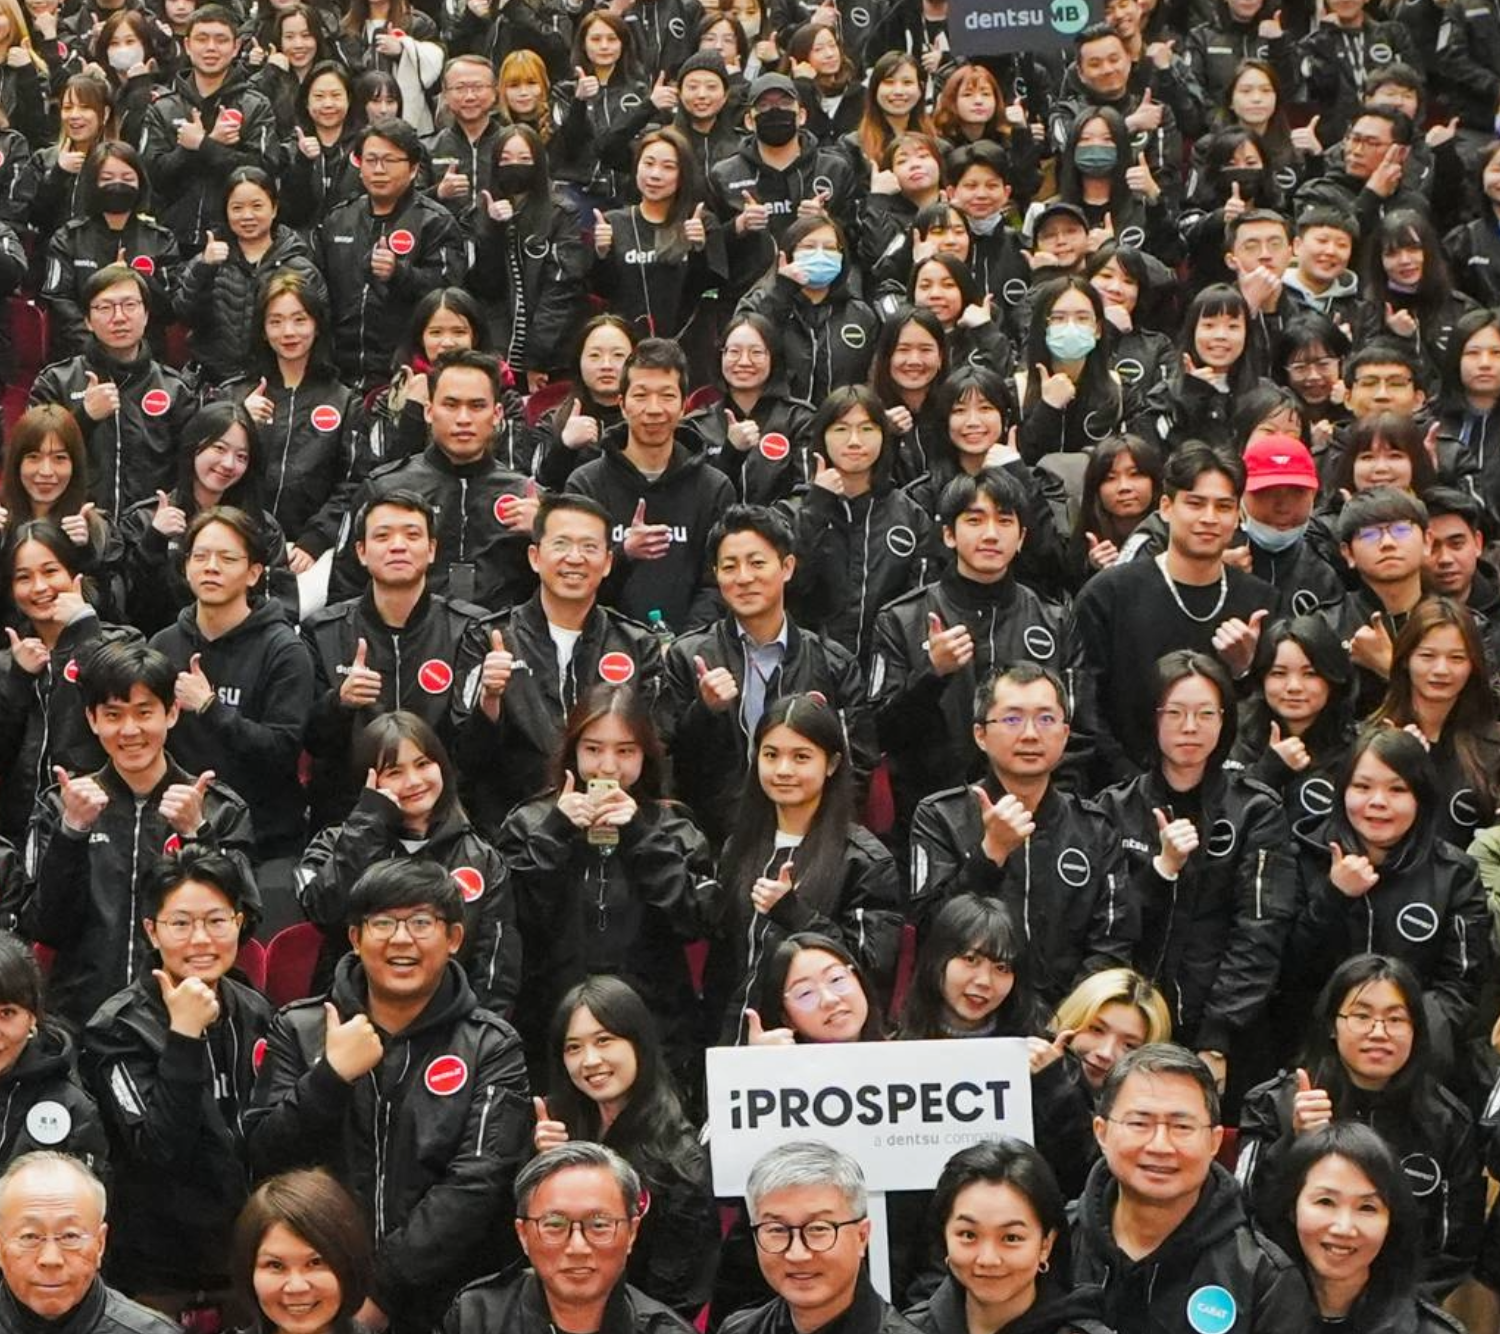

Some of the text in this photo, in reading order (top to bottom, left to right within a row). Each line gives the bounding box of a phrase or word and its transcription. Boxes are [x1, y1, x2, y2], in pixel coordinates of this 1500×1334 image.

[965, 5, 1043, 30] dentsu
[729, 1079, 1011, 1130] iPROSPECT
[886, 1132, 940, 1146] dentsu
